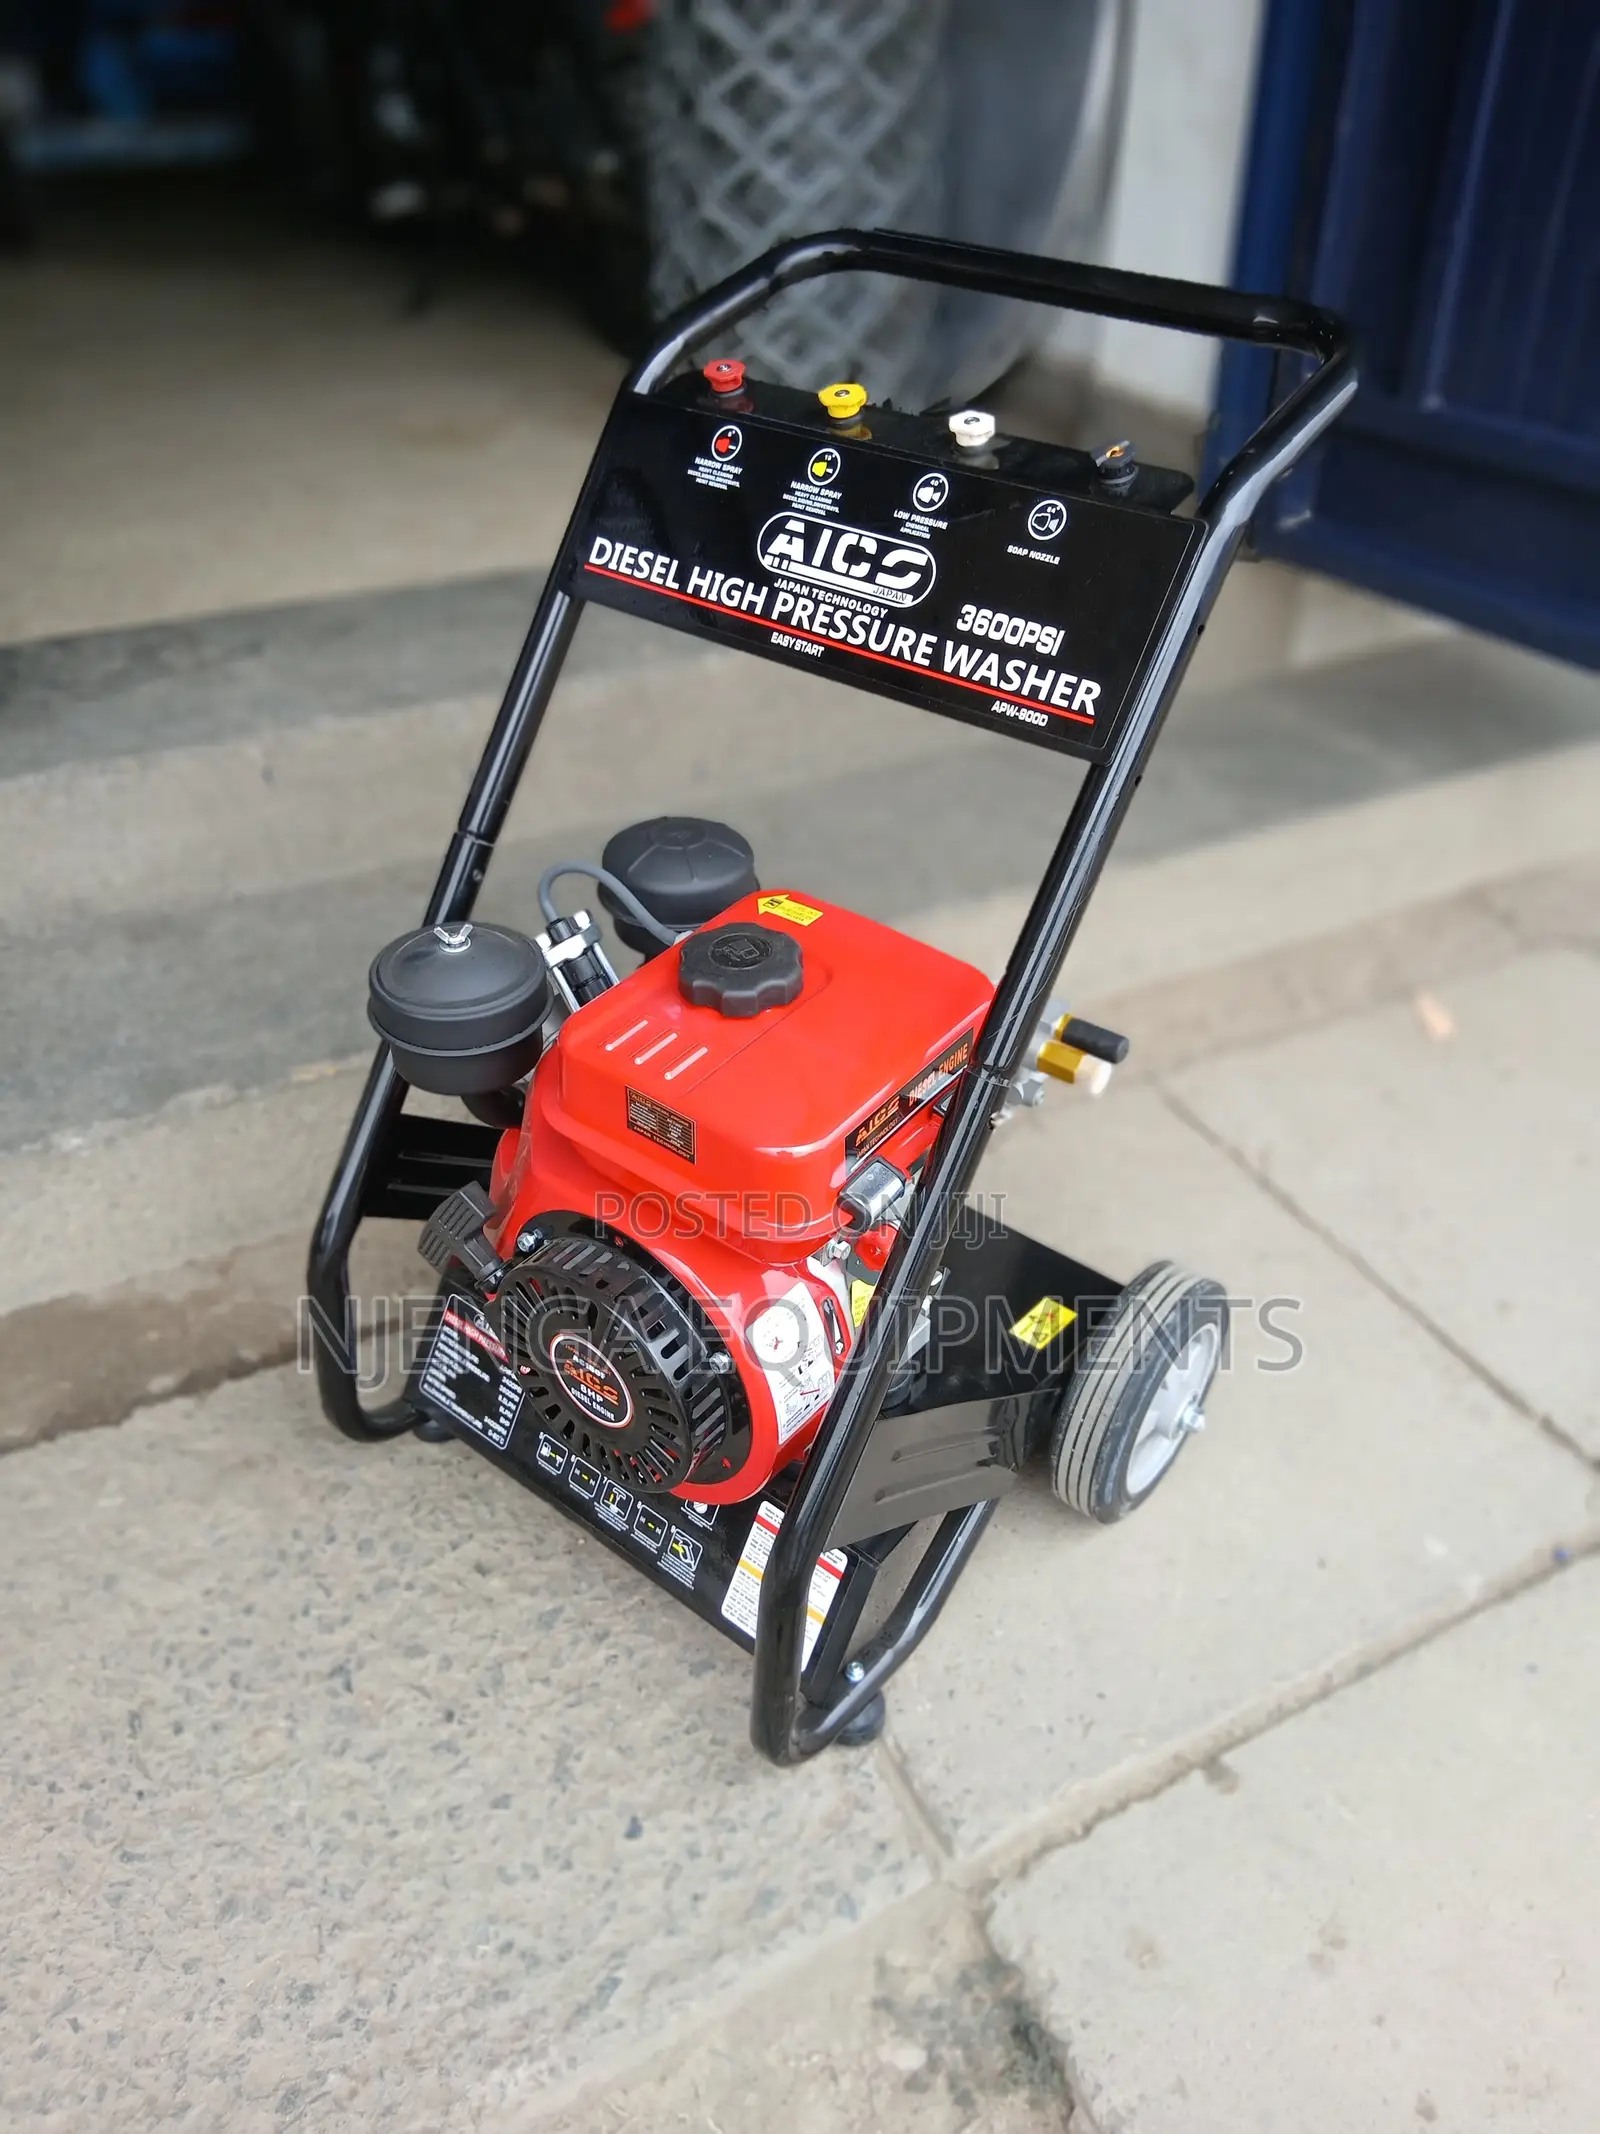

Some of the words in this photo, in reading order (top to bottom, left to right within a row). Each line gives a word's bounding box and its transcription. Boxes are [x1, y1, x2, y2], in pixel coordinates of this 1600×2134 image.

[694, 456, 722, 470] NARROW
[721, 463, 743, 475] SPRAY
[790, 480, 820, 495] NARROW
[819, 487, 843, 500] SPRAY
[893, 509, 910, 521] LOW
[910, 514, 949, 530] PRESSURE
[905, 521, 930, 533] CHEMICAL
[899, 527, 932, 540] APPLICATION
[756, 519, 929, 590] AICS
[1007, 544, 1029, 557] SOAP
[1028, 550, 1061, 565] NOZZLE
[774, 577, 812, 599] JAPAN
[811, 586, 889, 619] TECHNOLOGY
[872, 586, 908, 603] JAPAN
[588, 536, 680, 591] DIESEL
[686, 566, 769, 616] HIGH
[770, 591, 939, 667] PRESSURE
[942, 640, 1102, 716] WASHER
[956, 603, 1066, 656] 3600PSI
[770, 631, 797, 650] EASY
[794, 638, 826, 658] START
[908, 1070, 937, 1108] DIESEL
[938, 1042, 969, 1078] ENGINE
[633, 1125, 652, 1139] JAPAN
[652, 1134, 691, 1159] TECHNOLOGY
[570, 1387, 593, 1408] DIESEL
[592, 1401, 616, 1422] ENGINE
[580, 1382, 604, 1403] 8HP
